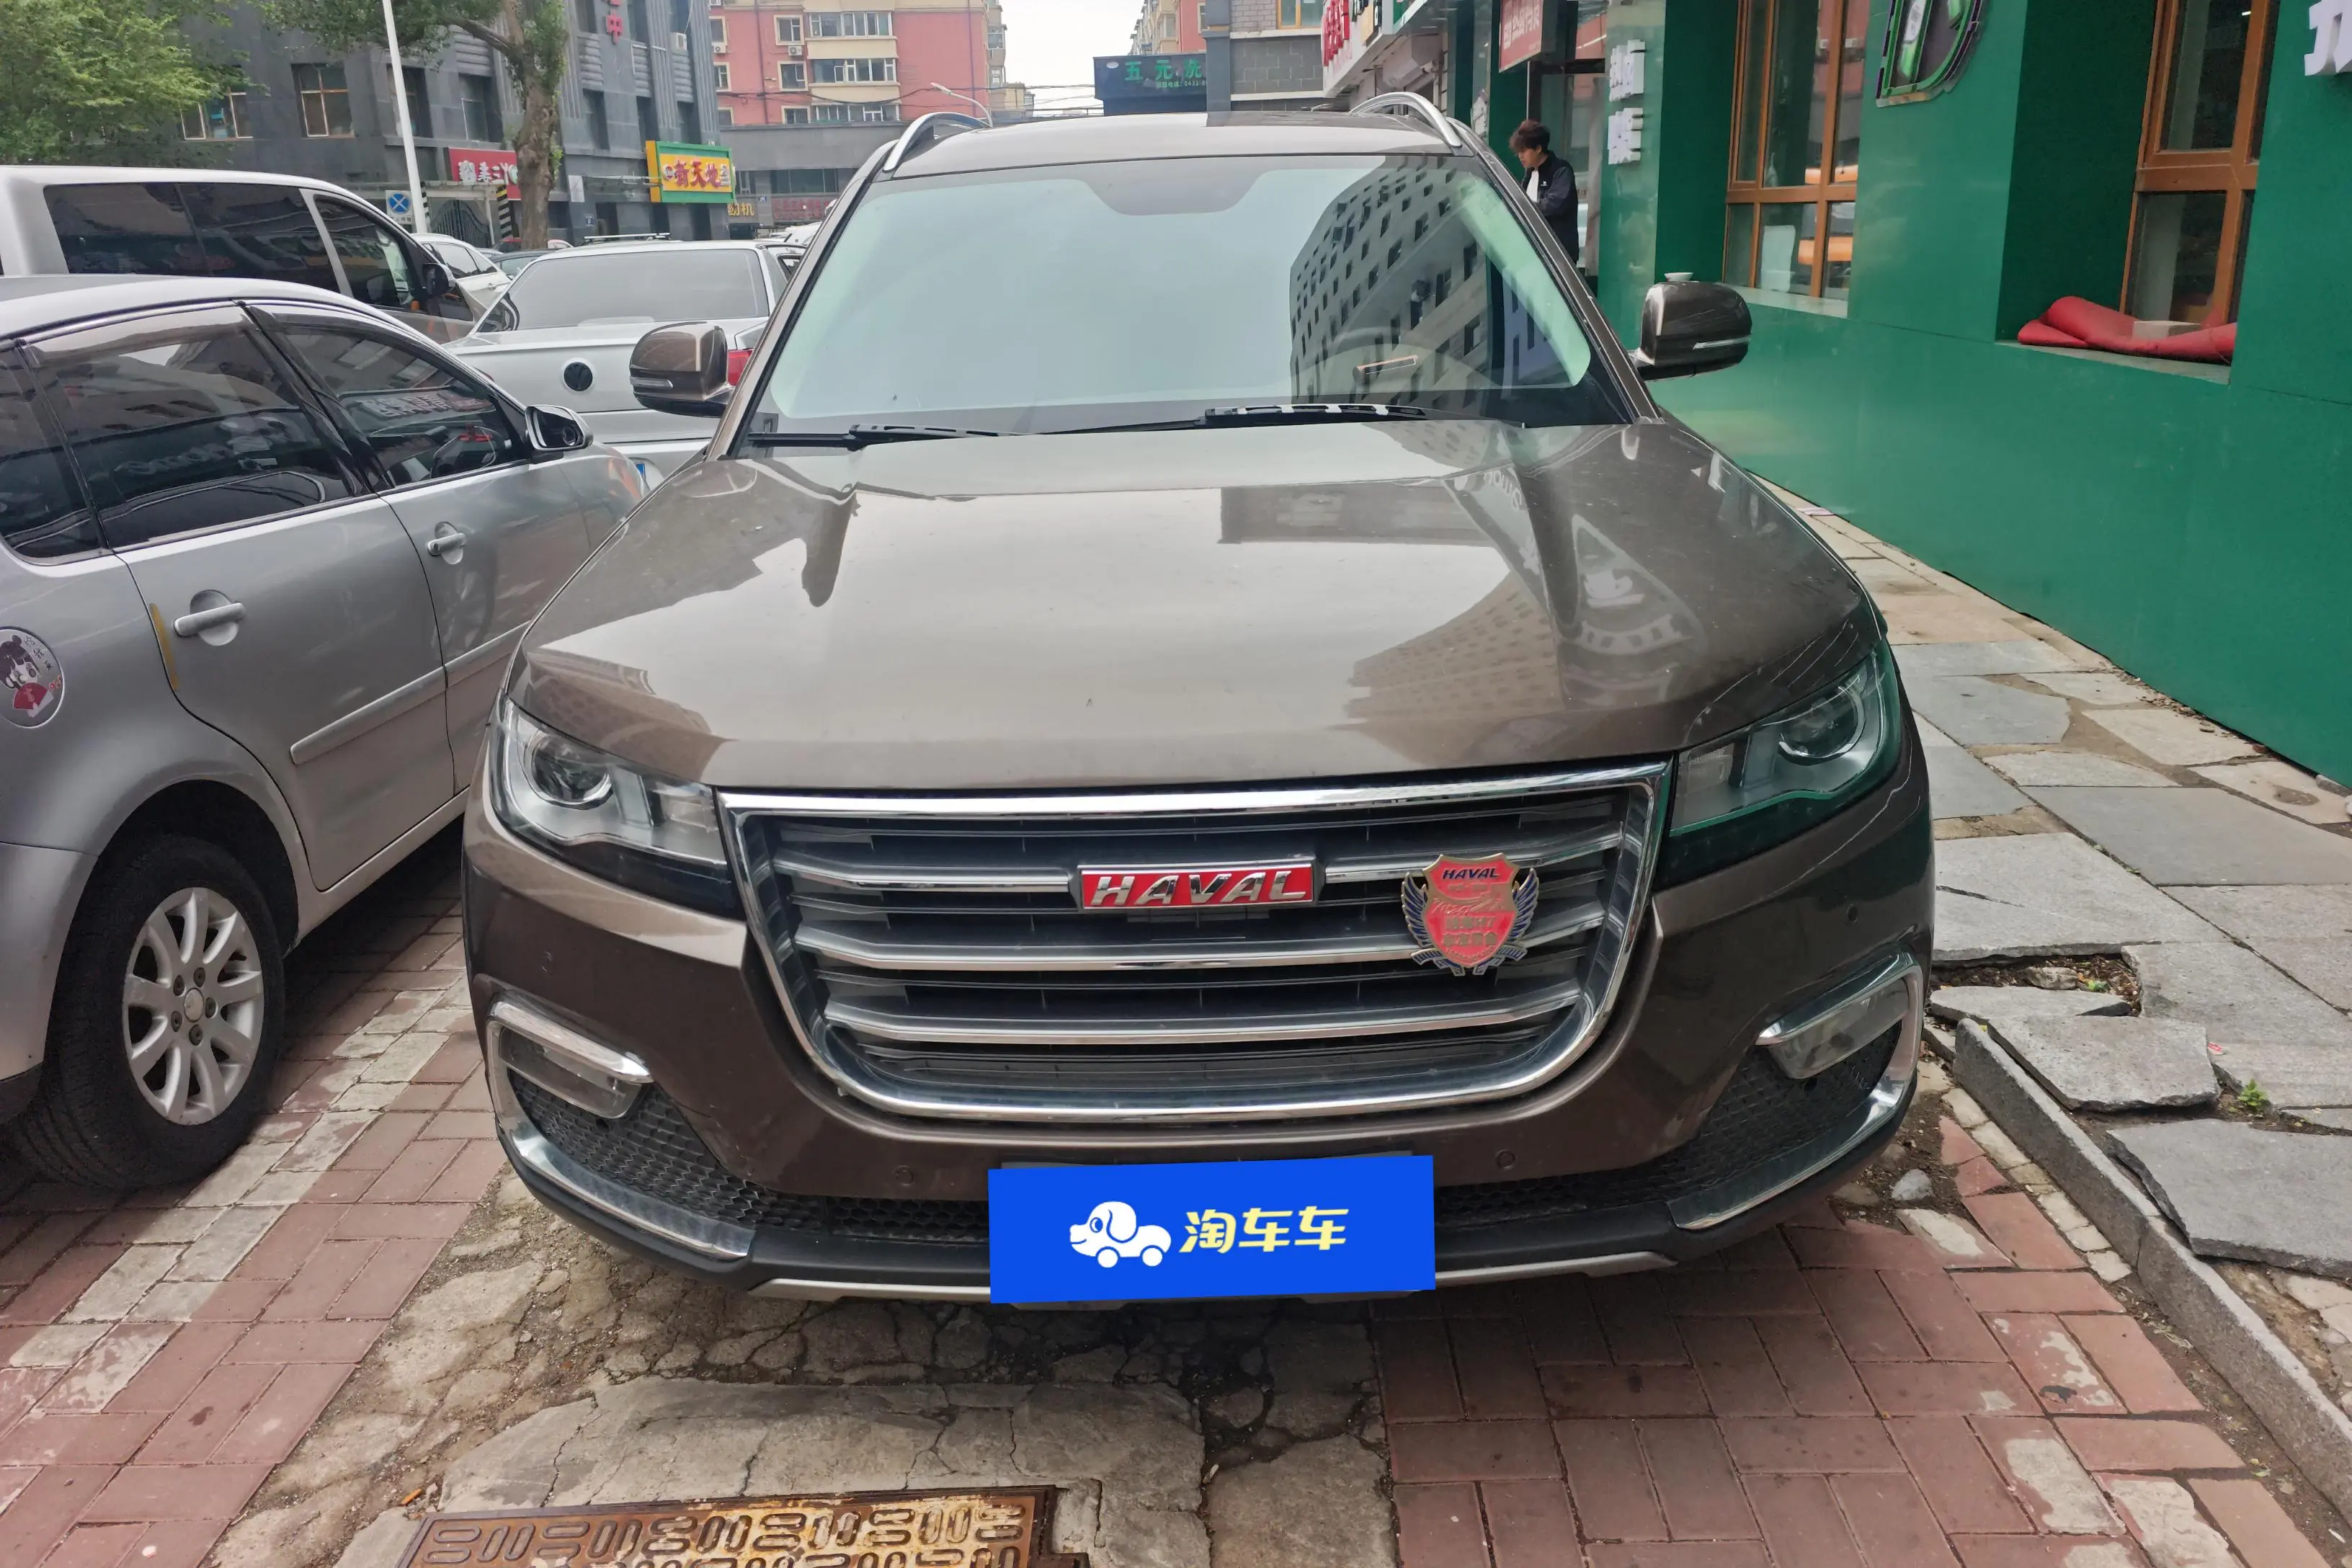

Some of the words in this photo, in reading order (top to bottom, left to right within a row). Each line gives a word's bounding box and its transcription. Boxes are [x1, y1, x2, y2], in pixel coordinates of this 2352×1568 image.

[1124, 58, 1202, 81] 五元洗
[1443, 868, 1500, 880] HAVAL
[1090, 870, 1306, 906] HAVAL
